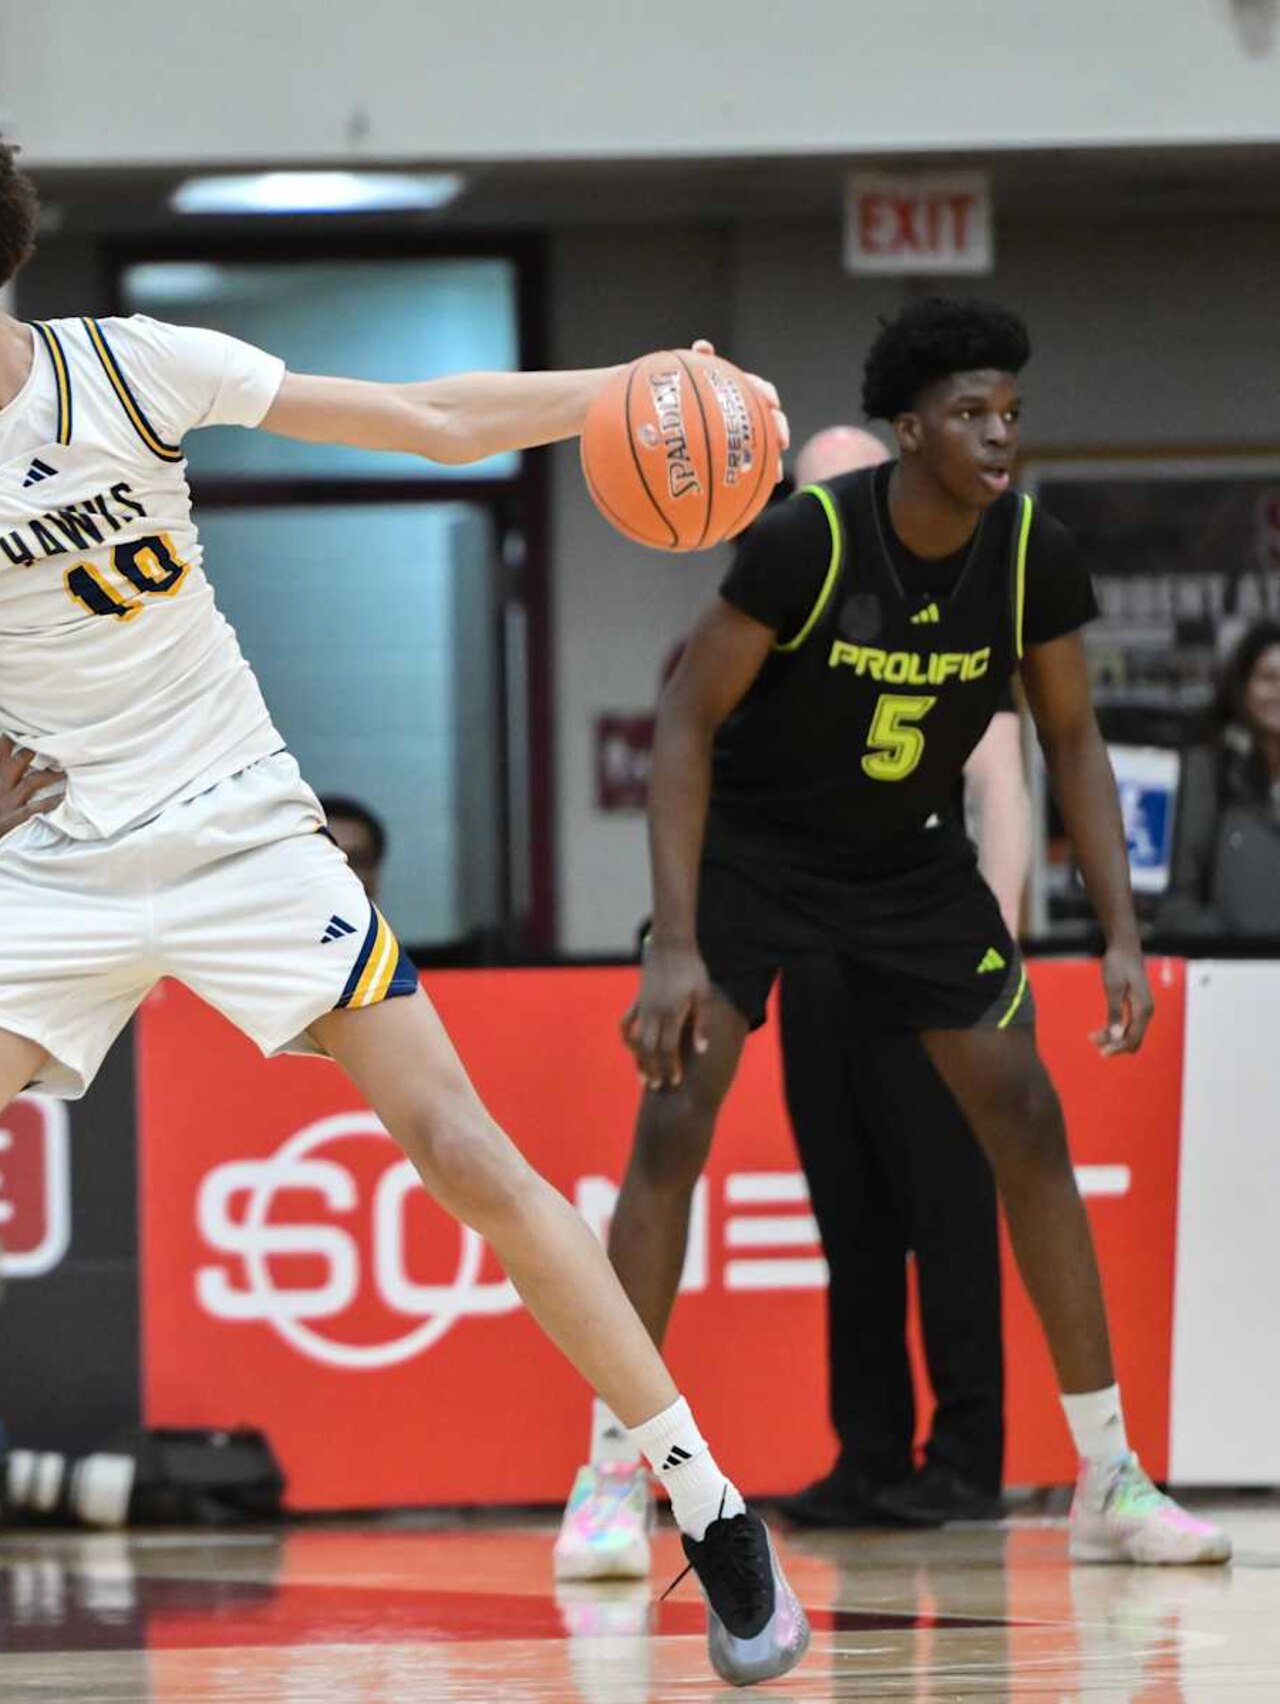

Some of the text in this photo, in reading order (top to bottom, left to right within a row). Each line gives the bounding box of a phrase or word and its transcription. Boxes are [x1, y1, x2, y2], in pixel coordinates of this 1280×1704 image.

[857, 193, 974, 253] EXIT
[649, 370, 702, 498] SPALDING
[62, 530, 192, 622] 10
[828, 640, 991, 685] PROLIFIC
[860, 694, 938, 782] 5
